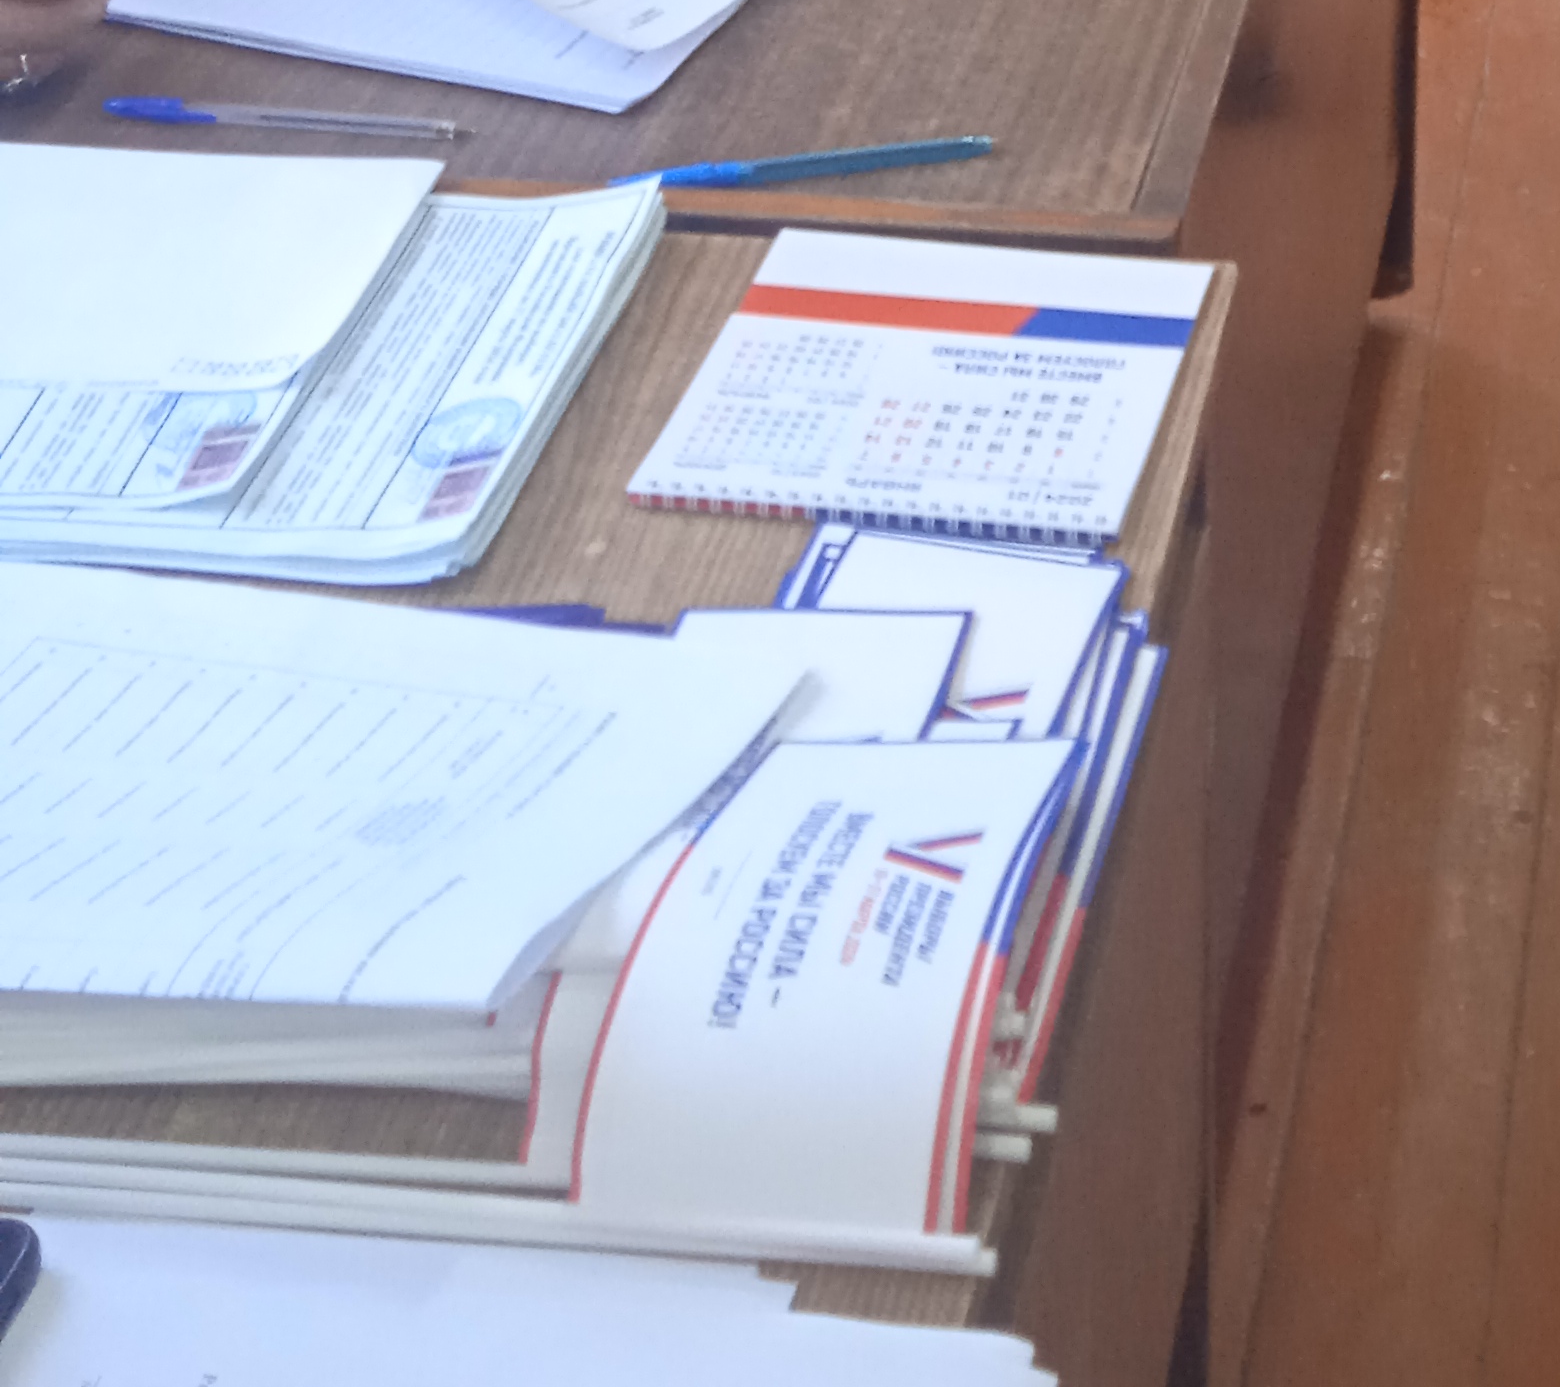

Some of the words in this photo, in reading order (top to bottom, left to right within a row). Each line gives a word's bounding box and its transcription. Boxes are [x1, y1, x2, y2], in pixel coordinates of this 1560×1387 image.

[770, 800, 842, 874] ГОЛОСУЕМ
[816, 811, 875, 869] ВМЕСТЕ
[754, 877, 793, 903] ЗА
[797, 873, 836, 908] МЫ
[874, 874, 910, 935] РОССИИ
[768, 914, 819, 979] СИЛА
[916, 889, 955, 965] ВЫБОРЫ
[707, 906, 778, 1029] РОССИЮ!
